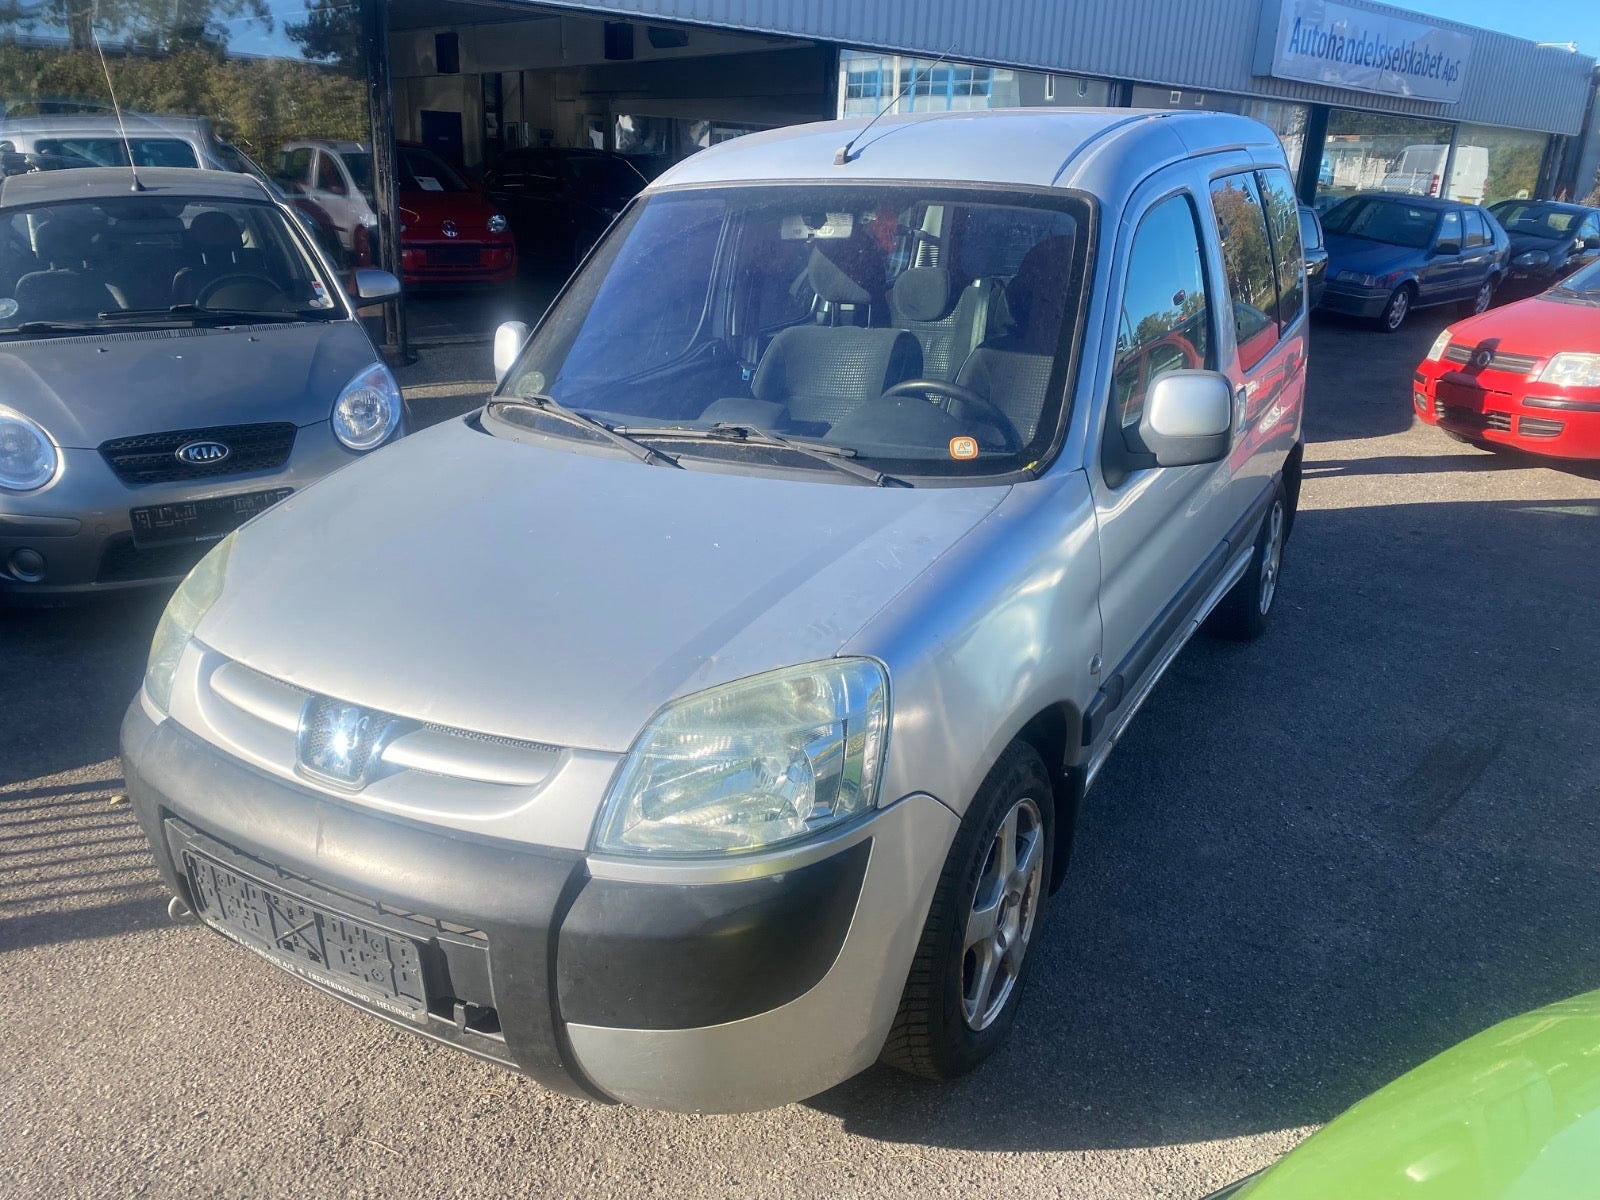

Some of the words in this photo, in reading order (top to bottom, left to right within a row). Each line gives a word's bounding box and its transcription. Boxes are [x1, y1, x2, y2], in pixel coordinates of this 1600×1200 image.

[1288, 17, 1443, 80] Autohandelsselskabet
[1442, 59, 1461, 87] ApS
[188, 446, 222, 460] KIA
